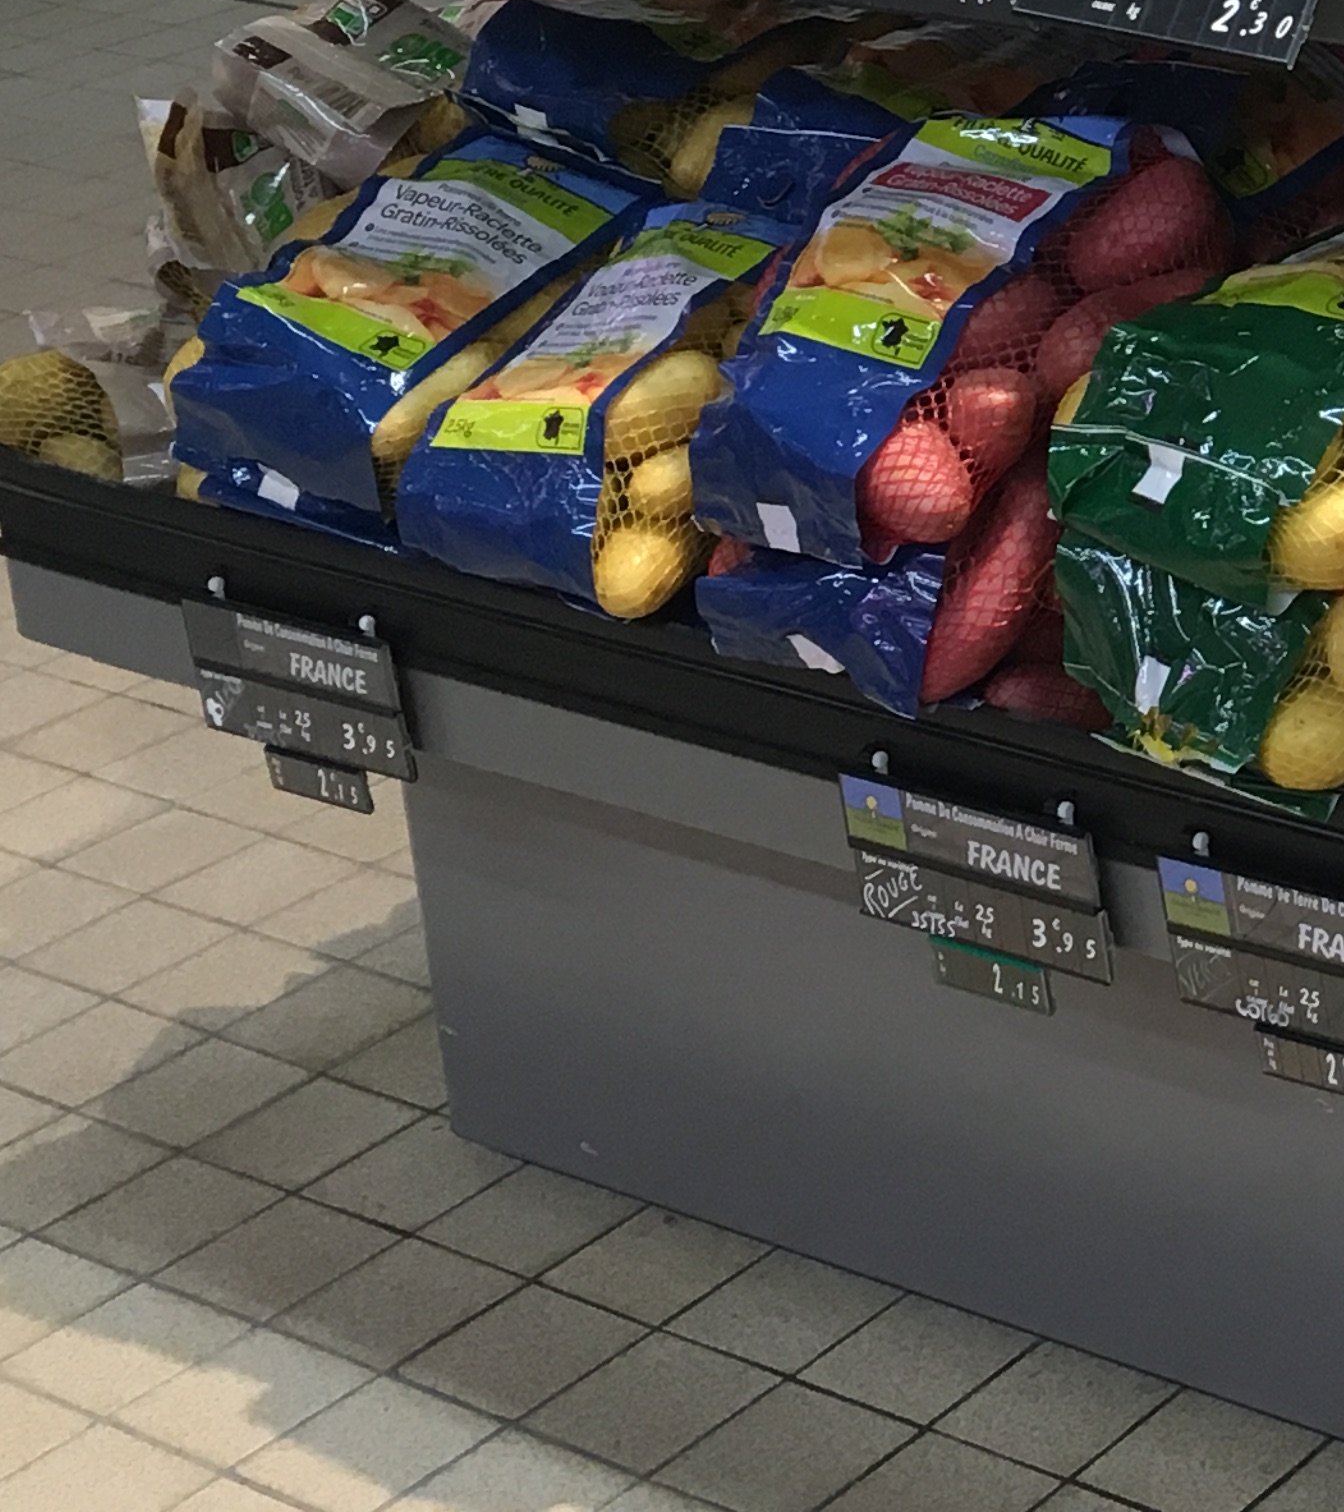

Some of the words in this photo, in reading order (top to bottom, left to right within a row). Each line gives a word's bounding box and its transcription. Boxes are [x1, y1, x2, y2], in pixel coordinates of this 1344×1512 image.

[1126, 4, 1141, 21] kg
[1019, 141, 1088, 174] QUALITÉ
[395, 185, 543, 254] Vapeur-Raclette
[510, 178, 579, 218] QUALITÉ
[380, 203, 527, 265] Gratin-Rissolées
[289, 652, 368, 695] FRANCE
[906, 792, 937, 816] Pomme
[938, 801, 951, 819] De
[952, 806, 1015, 836] Consommation
[1024, 825, 1048, 847] Chair
[1050, 833, 1078, 855] Ferme
[967, 840, 1062, 890] FRANCE
[863, 867, 923, 918] ROUGE
[1237, 875, 1273, 899] Pomme
[1276, 883, 1290, 904] De
[1292, 891, 1319, 911] Terre
[1321, 897, 1336, 915] De
